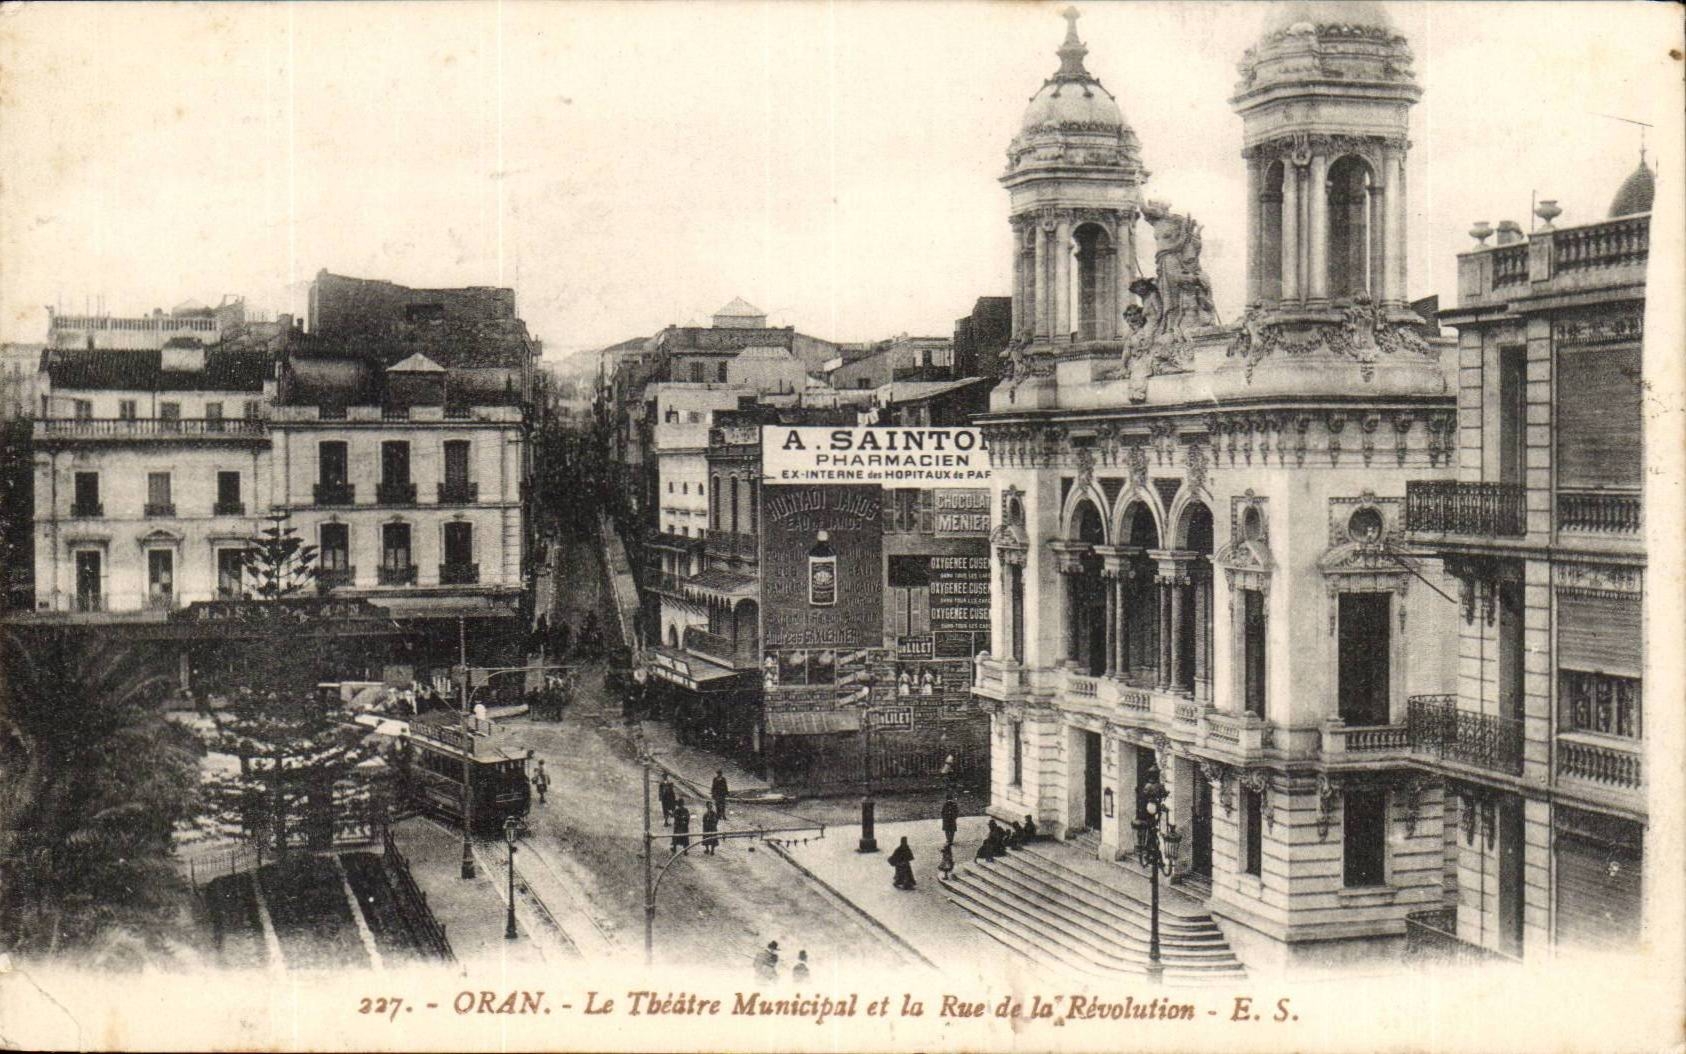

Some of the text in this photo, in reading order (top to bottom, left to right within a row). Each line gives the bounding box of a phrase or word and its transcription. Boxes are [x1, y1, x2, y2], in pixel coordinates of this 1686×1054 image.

[782, 430, 821, 451] A.
[816, 454, 969, 467] PHARMACIEN
[782, 470, 863, 479] EX-INTERNE
[867, 471, 882, 479] des
[885, 470, 951, 479] HOPITAUX
[953, 471, 963, 479] de
[938, 494, 990, 509] CHOCOLAT
[939, 514, 991, 532] MENIER
[970, 608, 991, 620] CUSE
